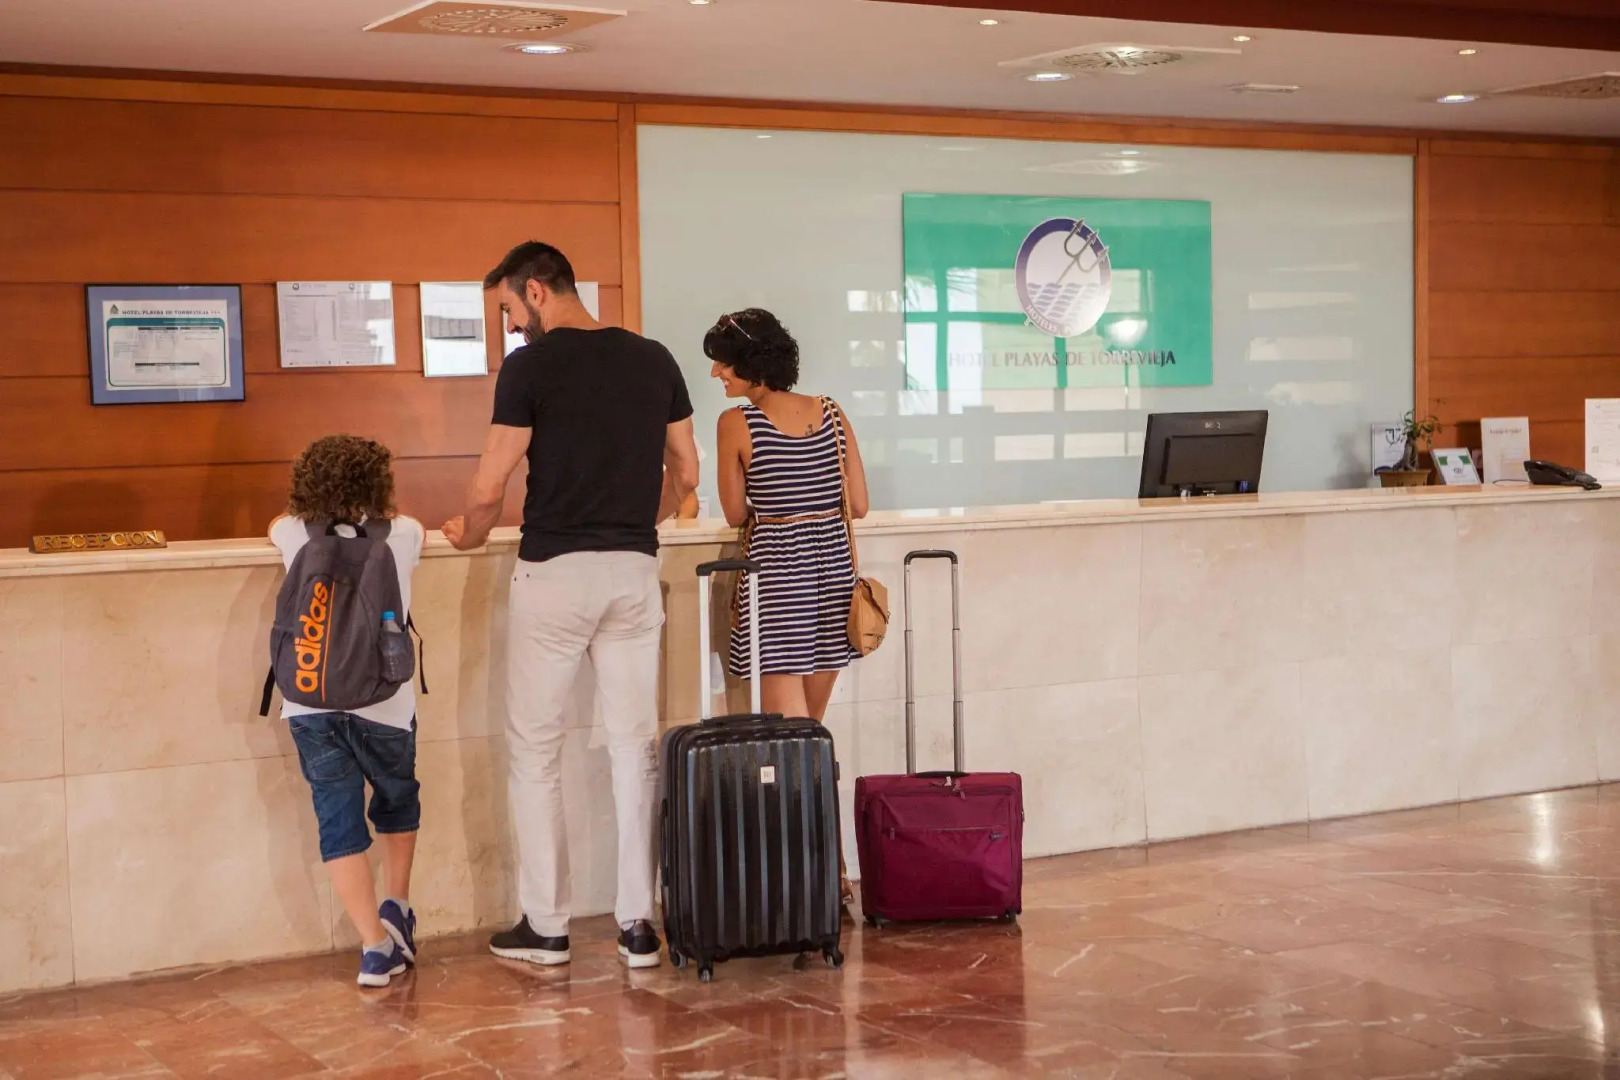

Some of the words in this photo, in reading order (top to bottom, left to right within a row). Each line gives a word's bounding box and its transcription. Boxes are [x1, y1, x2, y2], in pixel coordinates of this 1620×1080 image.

[1004, 351, 1059, 367] PLAYAS
[1065, 351, 1087, 367] DE
[1089, 350, 1176, 367] TORREVIEJA
[295, 582, 328, 692] adidas
